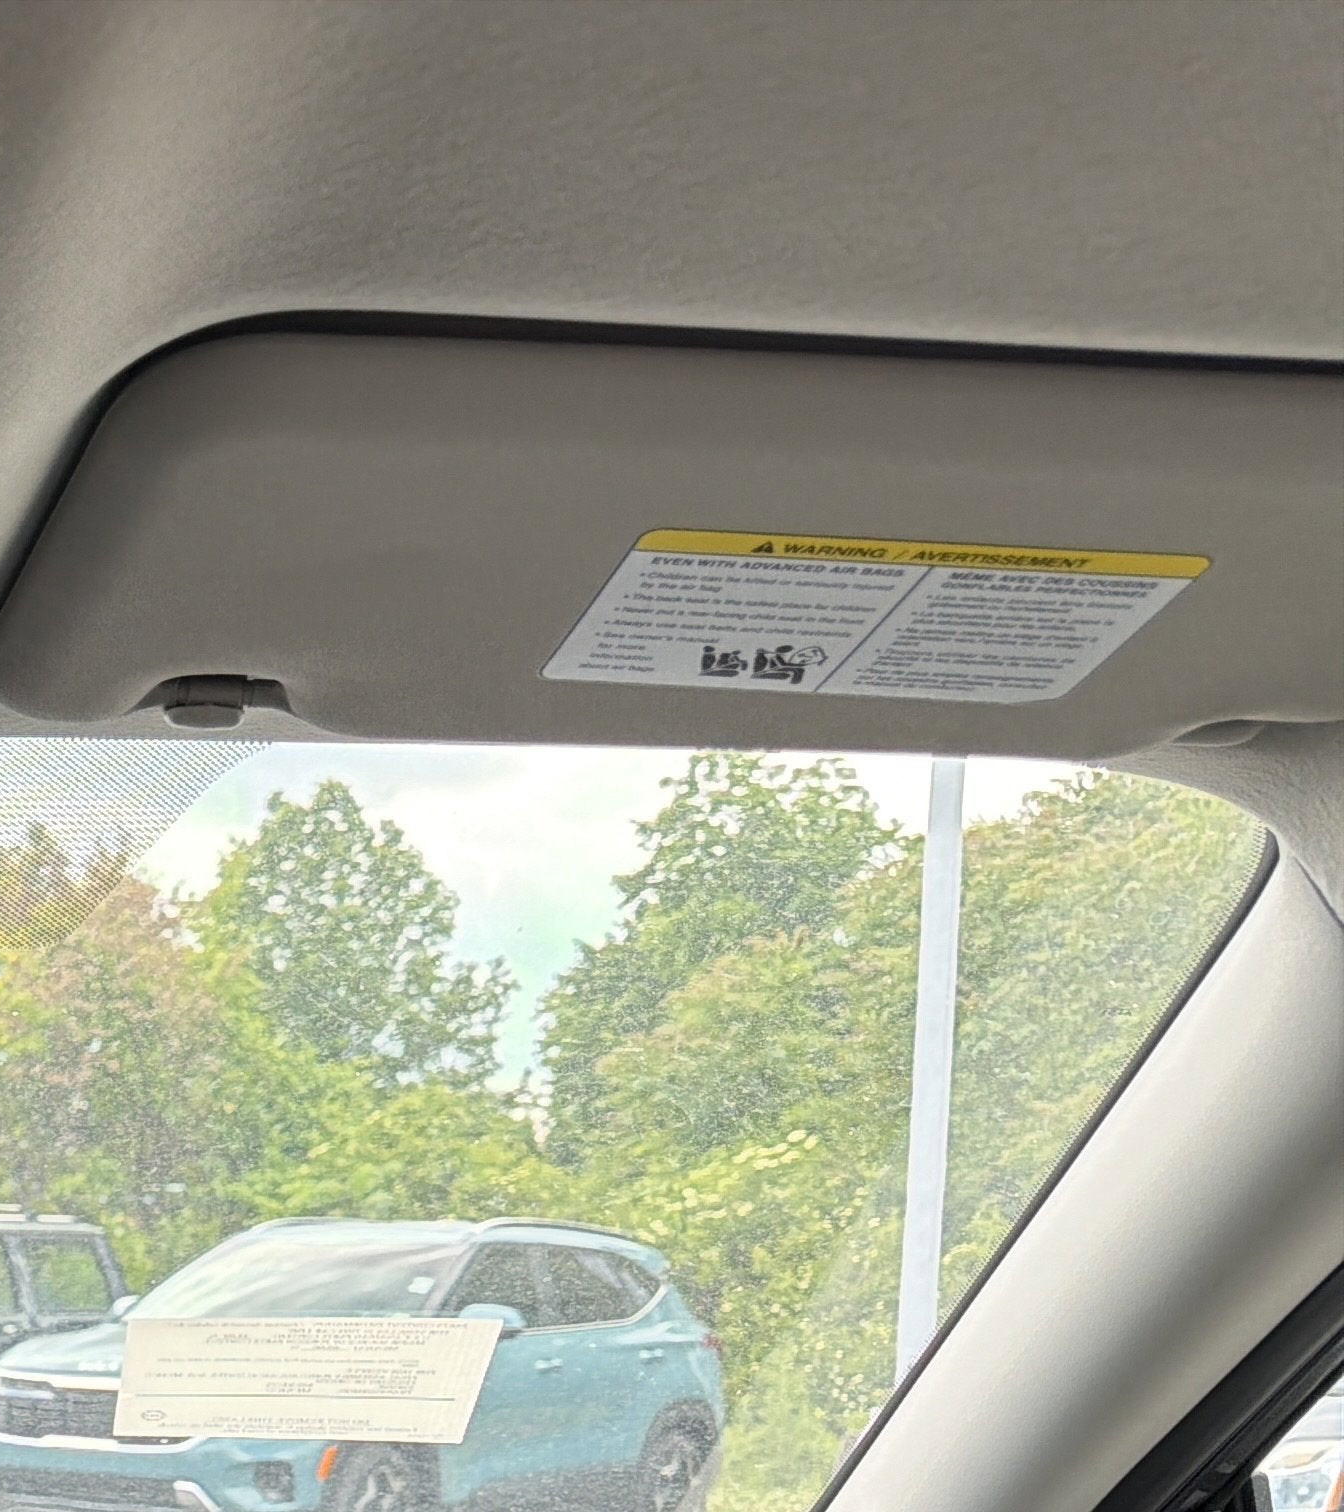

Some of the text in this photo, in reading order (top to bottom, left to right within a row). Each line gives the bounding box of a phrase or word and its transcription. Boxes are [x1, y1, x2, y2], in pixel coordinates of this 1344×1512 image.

[651, 556, 905, 577] EVEN WITH ADVANCED AIR BAGS
[783, 543, 1090, 568] WARNING AVERTISSEMENT
